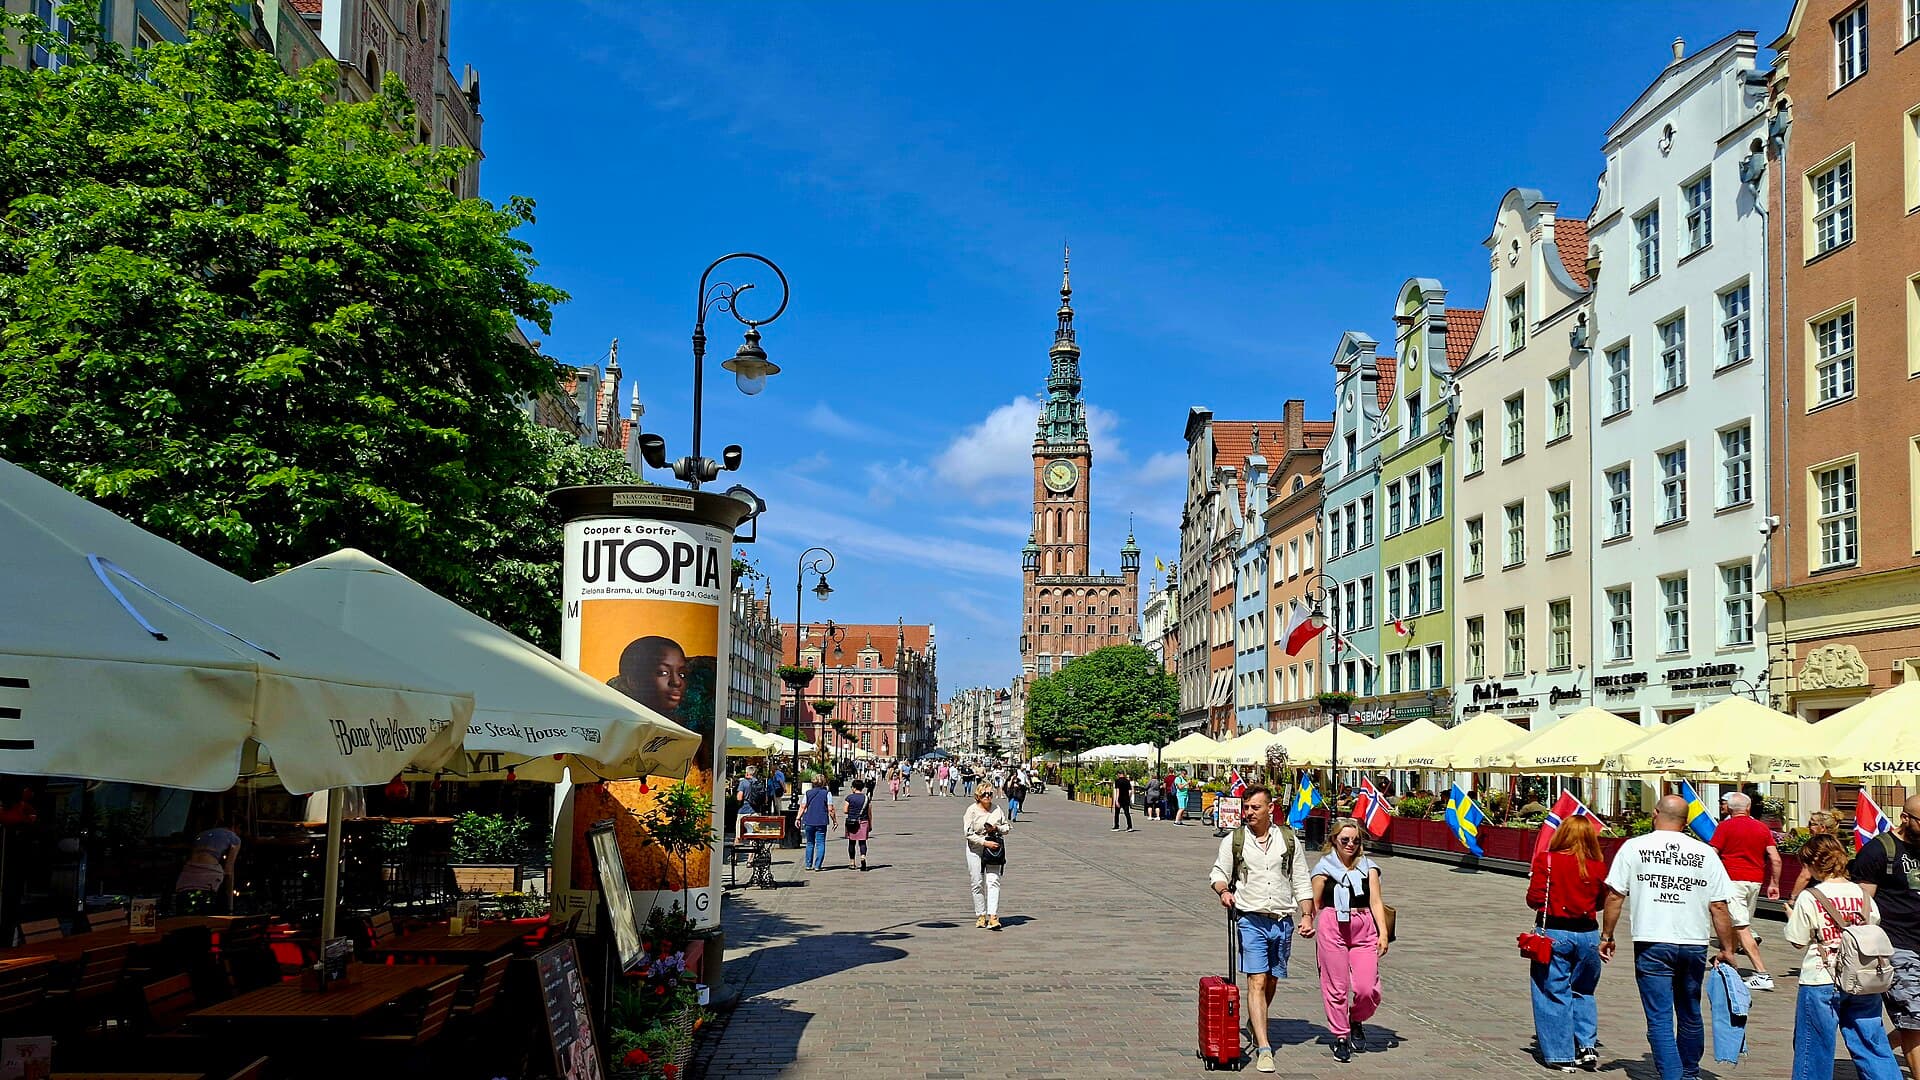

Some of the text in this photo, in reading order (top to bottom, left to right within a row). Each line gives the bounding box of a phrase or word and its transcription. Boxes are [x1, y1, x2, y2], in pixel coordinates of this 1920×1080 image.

[583, 525, 677, 536] Cooper & Gorfer
[582, 538, 720, 590] UTOPIA
[606, 587, 633, 595] Brama,
[646, 587, 667, 596] Długi
[668, 588, 685, 598] Targ
[686, 590, 697, 598] 24,
[567, 600, 579, 619] M
[1667, 668, 1694, 681] EFES
[1594, 676, 1614, 688] FISH
[484, 722, 523, 738] Steak
[523, 726, 568, 743] House
[1639, 849, 1705, 862] WHAT IS LOST
[1641, 856, 1704, 869] IN THE NOISE
[1644, 874, 1674, 883] OFTEN
[1678, 876, 1708, 887] FOUND
[1649, 881, 1692, 892] IN SPACE
[556, 893, 567, 912] N
[695, 892, 709, 911] G
[1660, 892, 1680, 901] NYC
